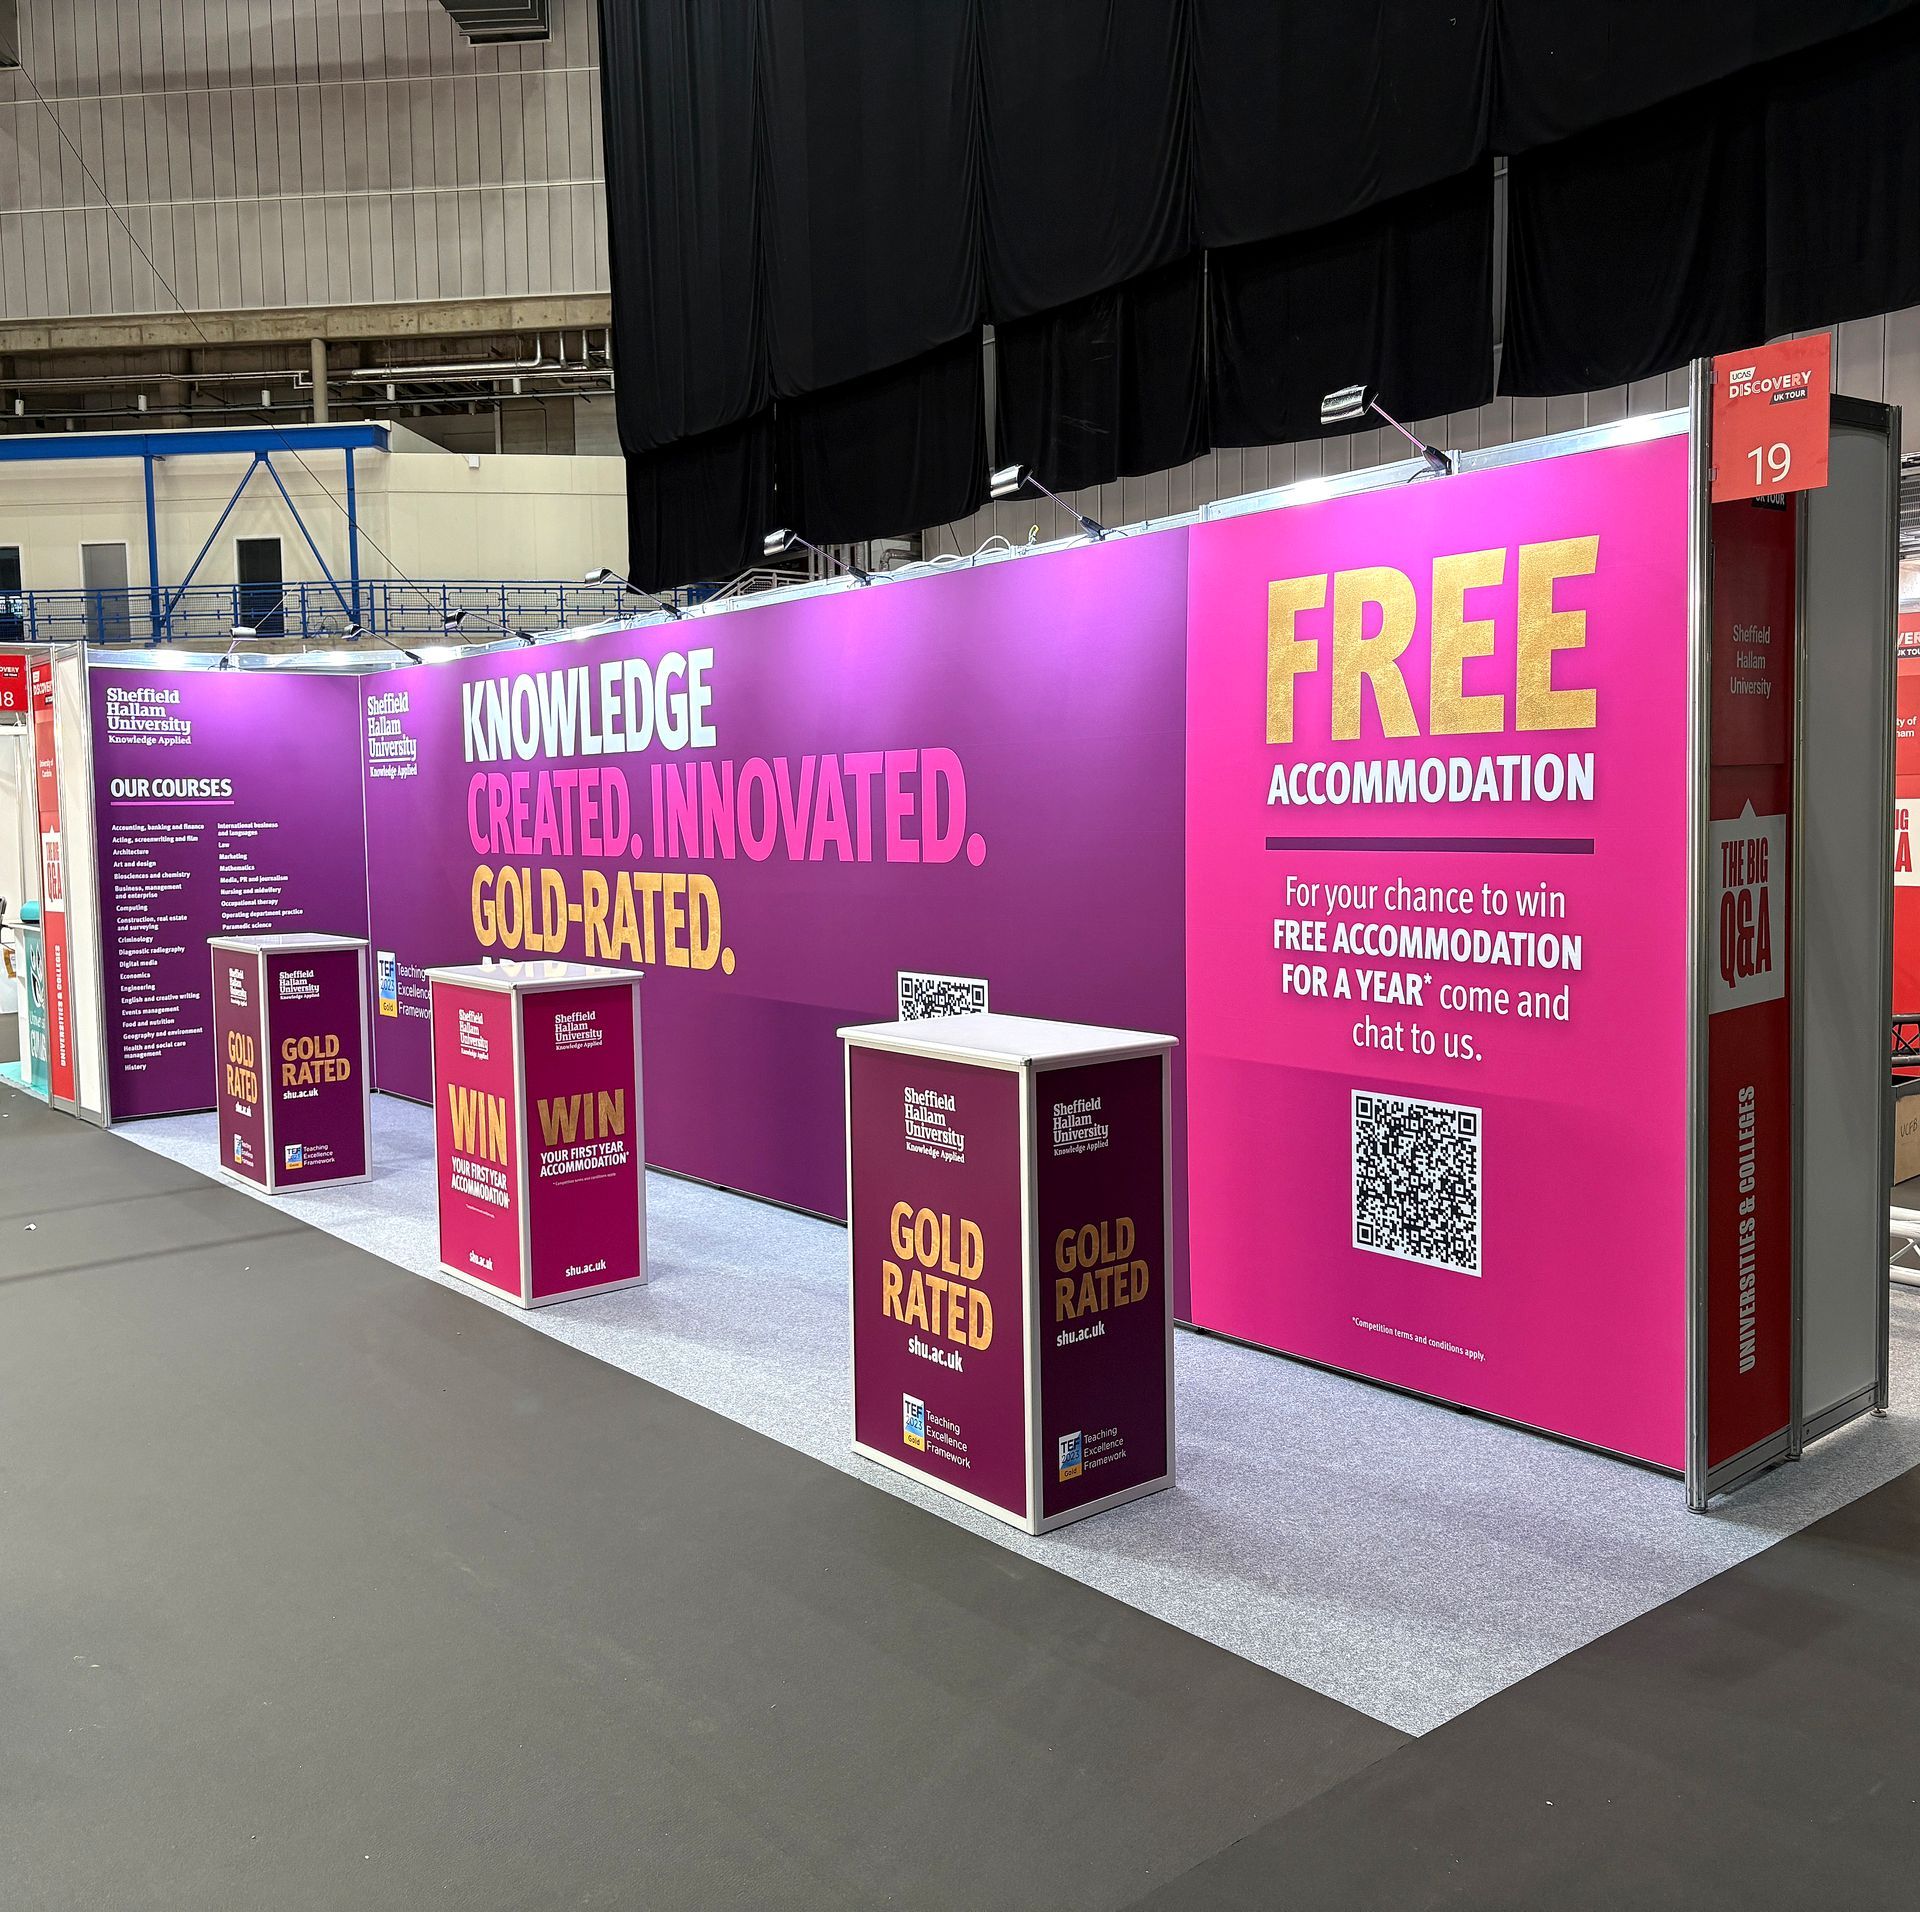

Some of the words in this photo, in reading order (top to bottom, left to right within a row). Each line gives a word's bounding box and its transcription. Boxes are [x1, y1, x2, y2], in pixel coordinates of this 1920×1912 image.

[1729, 371, 1812, 399] DISCOVERY
[1732, 370, 1751, 381] UCAS
[1773, 393, 1784, 401] UK
[1786, 390, 1805, 400] TOUR
[1748, 442, 1791, 485] 19
[1265, 534, 1600, 745] FREE
[1732, 624, 1771, 645] Sheffield
[1736, 651, 1766, 671] Hallam
[106, 688, 180, 703] Sheffield
[1730, 676, 1771, 699] University
[106, 702, 166, 717] Hallam
[368, 692, 409, 715] Sheffield
[462, 646, 717, 763] KNOWLEDGE
[107, 717, 191, 735] University
[368, 716, 401, 736] Hallam
[1907, 716, 1917, 725] of
[109, 736, 156, 746] Knowledge
[158, 736, 191, 746] Applied
[368, 734, 416, 761] University
[370, 765, 397, 779] Knowledge
[397, 763, 417, 779] Applied
[1266, 752, 1595, 805] ACCOMMODATION
[111, 779, 150, 797] OUR
[152, 779, 232, 797] COURSES
[466, 765, 644, 860] CREATED.
[651, 746, 988, 867] INNOVATED.
[1721, 839, 1744, 889] THE
[1747, 836, 1769, 884] BIG
[221, 899, 256, 907] Occupational
[258, 898, 278, 906] therapy
[1285, 874, 1320, 908] For
[1324, 884, 1378, 916] your
[1383, 877, 1474, 914] chance
[1481, 883, 1509, 916] to
[1515, 882, 1566, 919] win
[470, 864, 737, 976] GOLD-RATED.
[1273, 919, 1327, 951] FREE
[1331, 922, 1583, 971] ACCOMMODATION
[1719, 886, 1772, 989] Q&A
[279, 970, 314, 979] Sheffield
[379, 960, 394, 977] TEF
[397, 963, 426, 981] Teaching
[121, 984, 155, 992] Engineering
[280, 984, 319, 993] University
[381, 978, 394, 991] 2023
[1281, 963, 1328, 998] FOR
[1332, 970, 1352, 1000] A
[1438, 978, 1511, 1016] come
[1516, 984, 1571, 1021] and
[122, 996, 143, 1004] English
[180, 992, 200, 1000] writing
[383, 1002, 393, 1011] Gold
[143, 1006, 179, 1014] management
[399, 1001, 431, 1019] Framewor
[459, 1009, 483, 1024] Sheffield
[555, 1011, 596, 1024] Sheffield
[123, 1031, 155, 1040] Geography
[167, 1028, 202, 1036] environment
[459, 1021, 479, 1035] Hallam
[555, 1023, 588, 1033] Hallam
[555, 1030, 602, 1042] University
[228, 1031, 254, 1068] GOLD
[282, 1035, 339, 1061] GOLD
[460, 1033, 488, 1051] University
[1351, 1017, 1405, 1052] chat
[1410, 1021, 1437, 1056] to
[1443, 1030, 1484, 1062] us.
[282, 1058, 350, 1086] RATED
[226, 1064, 257, 1104] RATED
[283, 1088, 318, 1099] shu.ac.uk
[904, 1087, 955, 1112] Sheffield
[1054, 1097, 1101, 1116] Sheffield
[448, 1084, 508, 1166] WIN
[537, 1089, 625, 1146] WIN
[904, 1103, 946, 1126] Hallam
[1053, 1114, 1092, 1130] Hallam
[905, 1120, 964, 1152] University
[1053, 1124, 1109, 1143] University
[1739, 1086, 1756, 1193] COLLEGES
[304, 1151, 333, 1159] Excellence
[540, 1150, 568, 1164] YOUR
[571, 1144, 597, 1160] FIRST
[599, 1141, 623, 1153] YEAR
[906, 1142, 940, 1158] Knowledge
[941, 1149, 965, 1164] Applied
[1054, 1144, 1085, 1156] Knowledge
[1087, 1139, 1109, 1151] Applied
[304, 1158, 335, 1166] Framework
[452, 1156, 470, 1177] YOUR
[472, 1162, 490, 1184] FIRST
[490, 1169, 507, 1190] YEAR
[1739, 1195, 1756, 1216] &
[890, 1200, 985, 1282] GOLD
[1054, 1216, 1135, 1273] GOLD
[469, 1250, 493, 1271] shu.ac.uk
[565, 1259, 606, 1277] shu.ac.uk
[1054, 1259, 1150, 1324] RATED
[1739, 1217, 1756, 1374] UNIVERSITIES
[881, 1259, 994, 1352] RATED
[1056, 1323, 1105, 1347] shu.ac.uk
[1394, 1329, 1413, 1340] terms
[1414, 1336, 1427, 1345] and
[1428, 1338, 1463, 1354] conditions
[1465, 1349, 1486, 1361] apply.
[908, 1335, 963, 1373] shu.ac.uk
[905, 1400, 922, 1418] TEF
[906, 1416, 923, 1431] 2023
[926, 1410, 960, 1435] Teaching
[908, 1434, 920, 1446] Gold
[927, 1426, 968, 1452] Excellence
[1061, 1436, 1080, 1451] TEF
[1084, 1426, 1118, 1443] Teaching
[926, 1440, 971, 1469] Framework
[1061, 1451, 1080, 1464] 2023
[1084, 1437, 1124, 1458] Excellence
[1083, 1450, 1127, 1471] Framework
[1064, 1468, 1077, 1477] Gold
